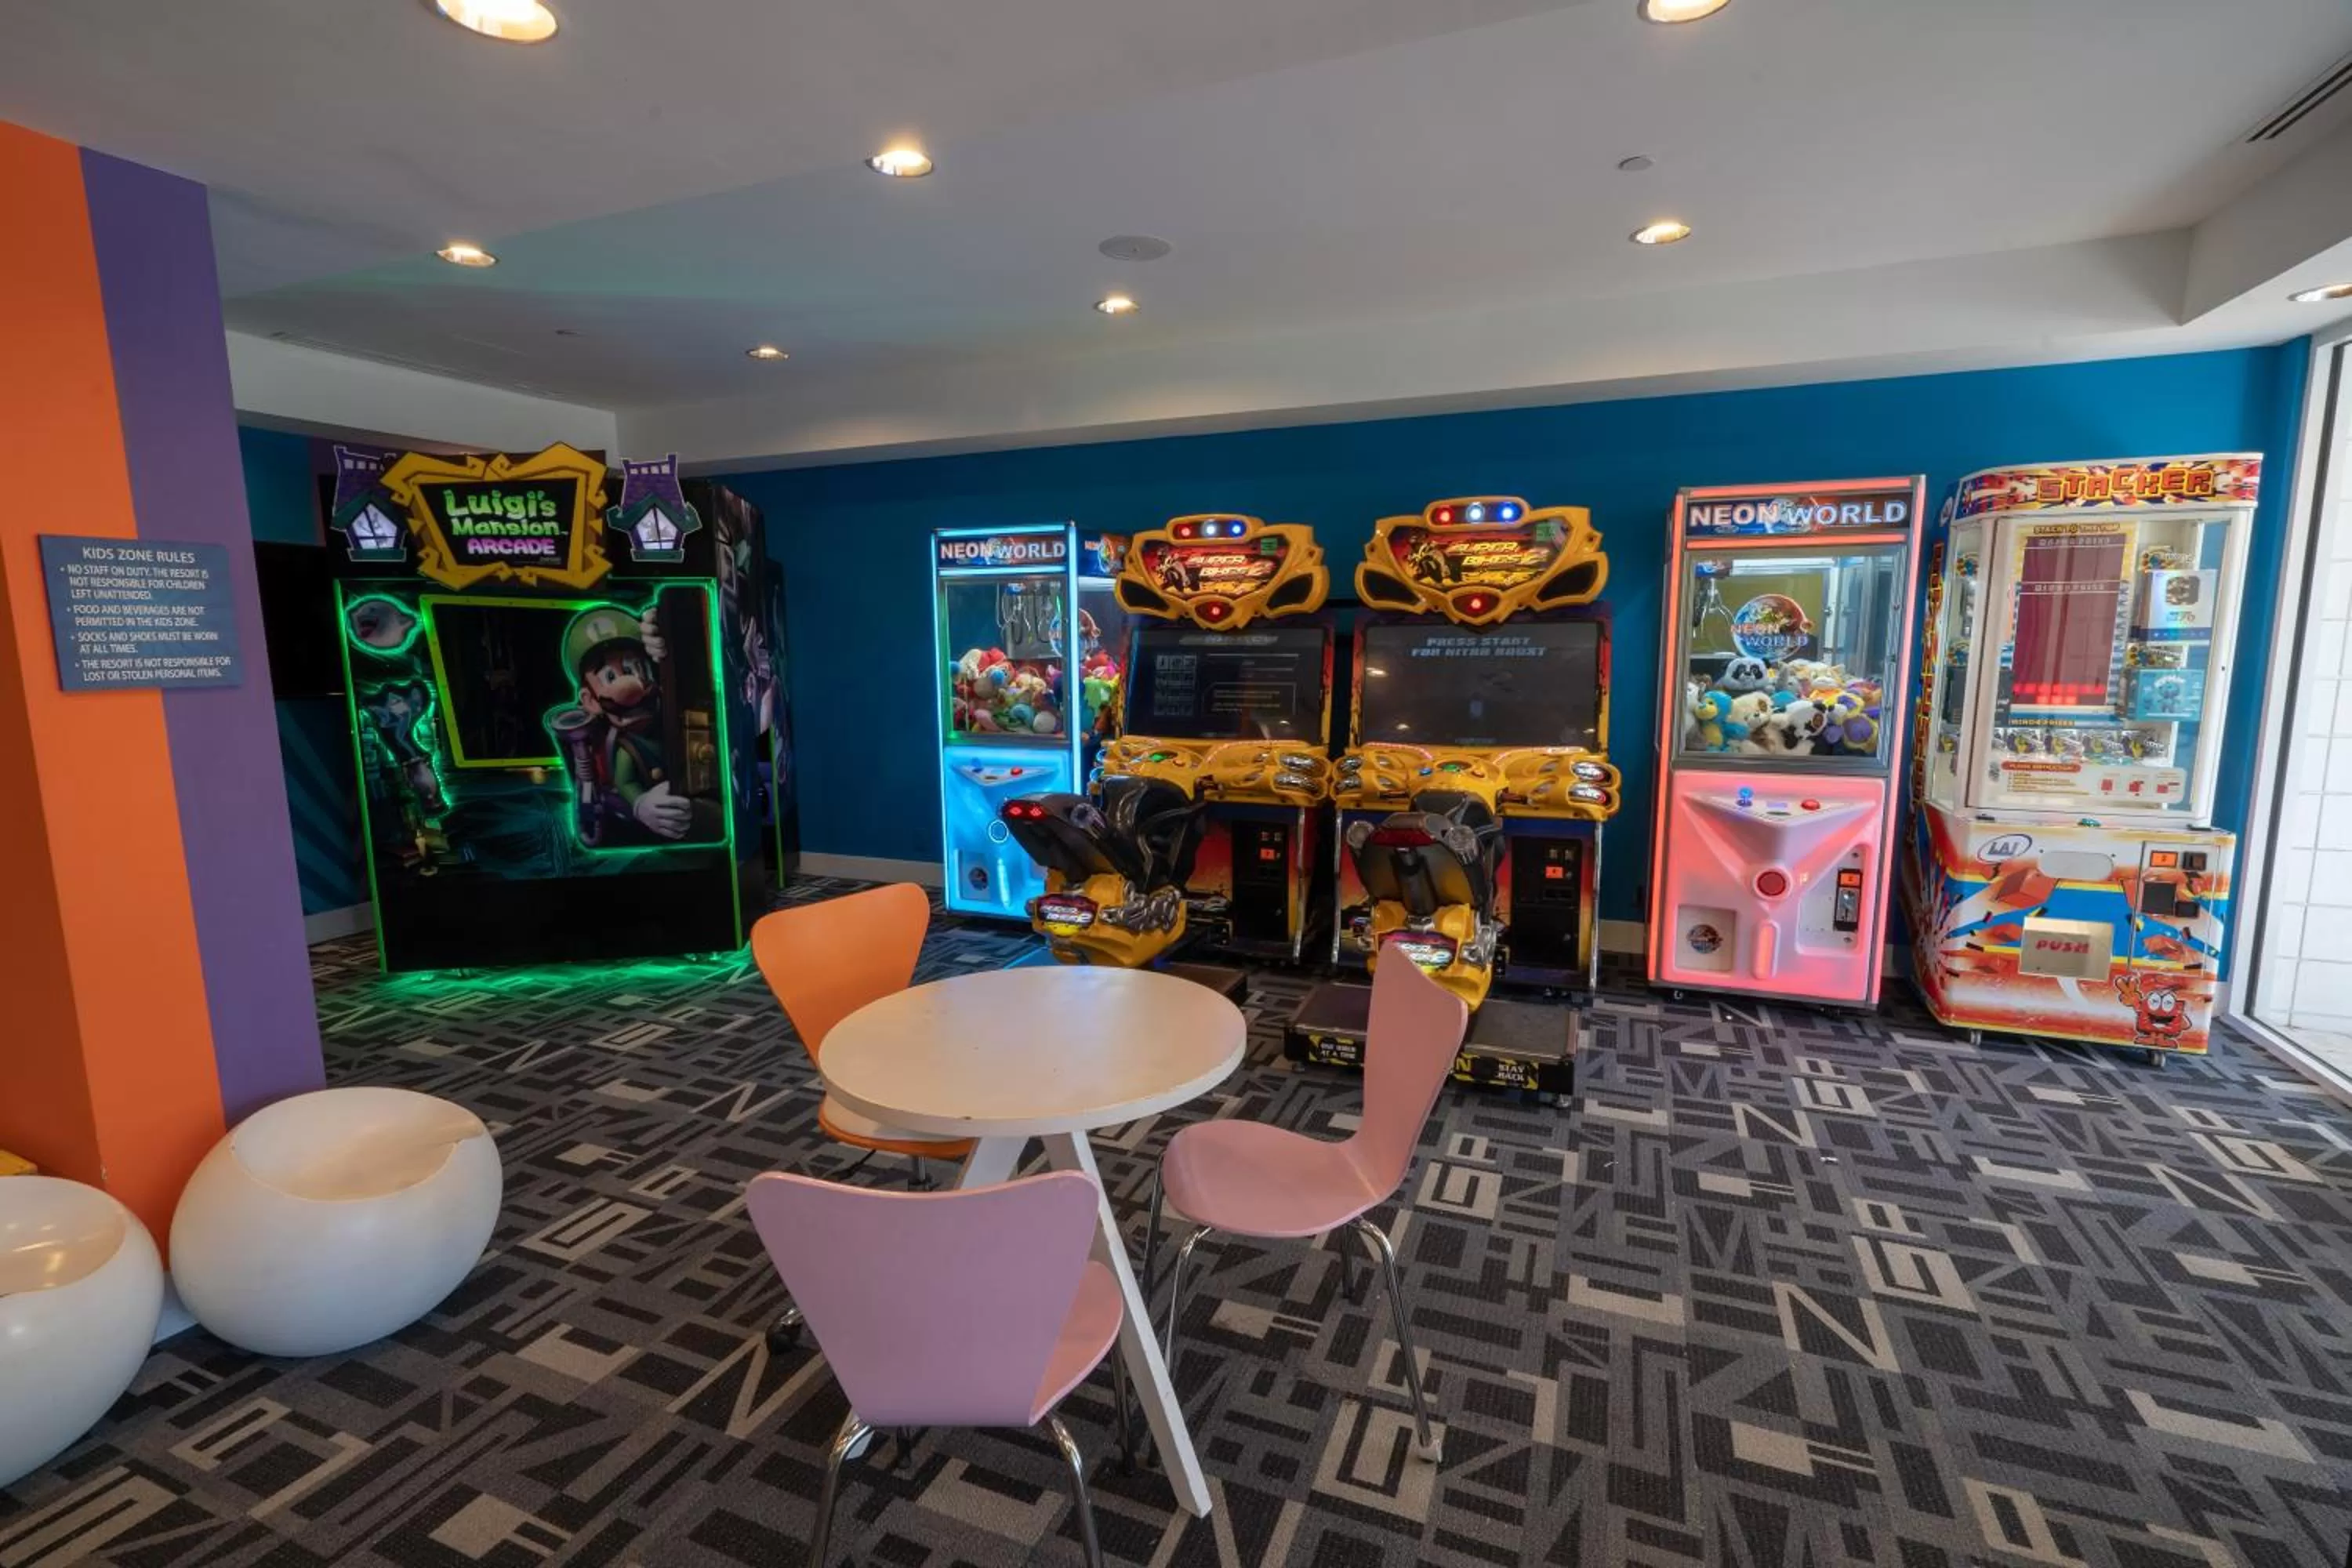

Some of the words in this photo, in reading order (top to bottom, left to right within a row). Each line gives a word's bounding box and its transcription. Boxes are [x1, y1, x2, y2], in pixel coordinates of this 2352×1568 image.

[2038, 467, 2216, 502] STACKER
[443, 489, 557, 519] Luigi's
[1690, 503, 1779, 527] NEON
[1786, 499, 1908, 526] WORLD
[450, 517, 560, 535] Mansion
[467, 537, 556, 555] ARCADE
[940, 541, 993, 559] NEON
[994, 540, 1066, 559] WORLD
[1446, 541, 1519, 555] SUPER
[82, 546, 114, 560] KIDS
[118, 549, 154, 562] ZONE
[157, 551, 195, 564] RULES
[1185, 554, 1247, 565] SUPER
[67, 564, 82, 575] NO
[84, 564, 110, 575] STAFF
[111, 566, 125, 575] ON
[153, 567, 169, 577] THE
[170, 568, 201, 578] RESORT
[201, 569, 209, 579] IS
[69, 576, 89, 586] NOT
[90, 577, 147, 588] RESPONSIBLE
[148, 579, 165, 589] FOR
[165, 580, 205, 590] CHILDREN
[71, 589, 92, 599] LEFT
[73, 604, 100, 614] FOOD
[101, 604, 121, 615] AND
[122, 605, 170, 615] BEVERAGES
[171, 606, 187, 615] ARE
[187, 606, 205, 615] NOT
[75, 617, 124, 626] PERMITTED
[125, 617, 136, 626] IN
[136, 617, 153, 626] THE
[154, 617, 173, 626] KIDS
[1730, 624, 1780, 634] NEON
[78, 631, 107, 642] SOCKS
[109, 631, 128, 641] AND
[129, 631, 157, 641] SHOES
[158, 631, 180, 641] MUST
[182, 631, 193, 641] BE
[194, 631, 219, 641] WORN
[1426, 637, 1477, 647] PRESS
[1479, 637, 1532, 646] START
[1743, 633, 1809, 648] WORLD
[80, 644, 92, 654] AT
[93, 644, 108, 654] ALL
[82, 659, 100, 669] THE
[100, 659, 134, 669] RESORT
[135, 658, 143, 668] IS
[144, 658, 162, 668] NOT
[163, 657, 214, 667] RESPONSIBLE
[216, 656, 231, 666] FOR
[83, 670, 107, 681] LOST
[108, 670, 120, 681] OR
[122, 670, 154, 680] STOLEN
[154, 668, 195, 679] PERSONAL
[1987, 841, 2020, 856] LAI
[2035, 939, 2089, 954] PUSH
